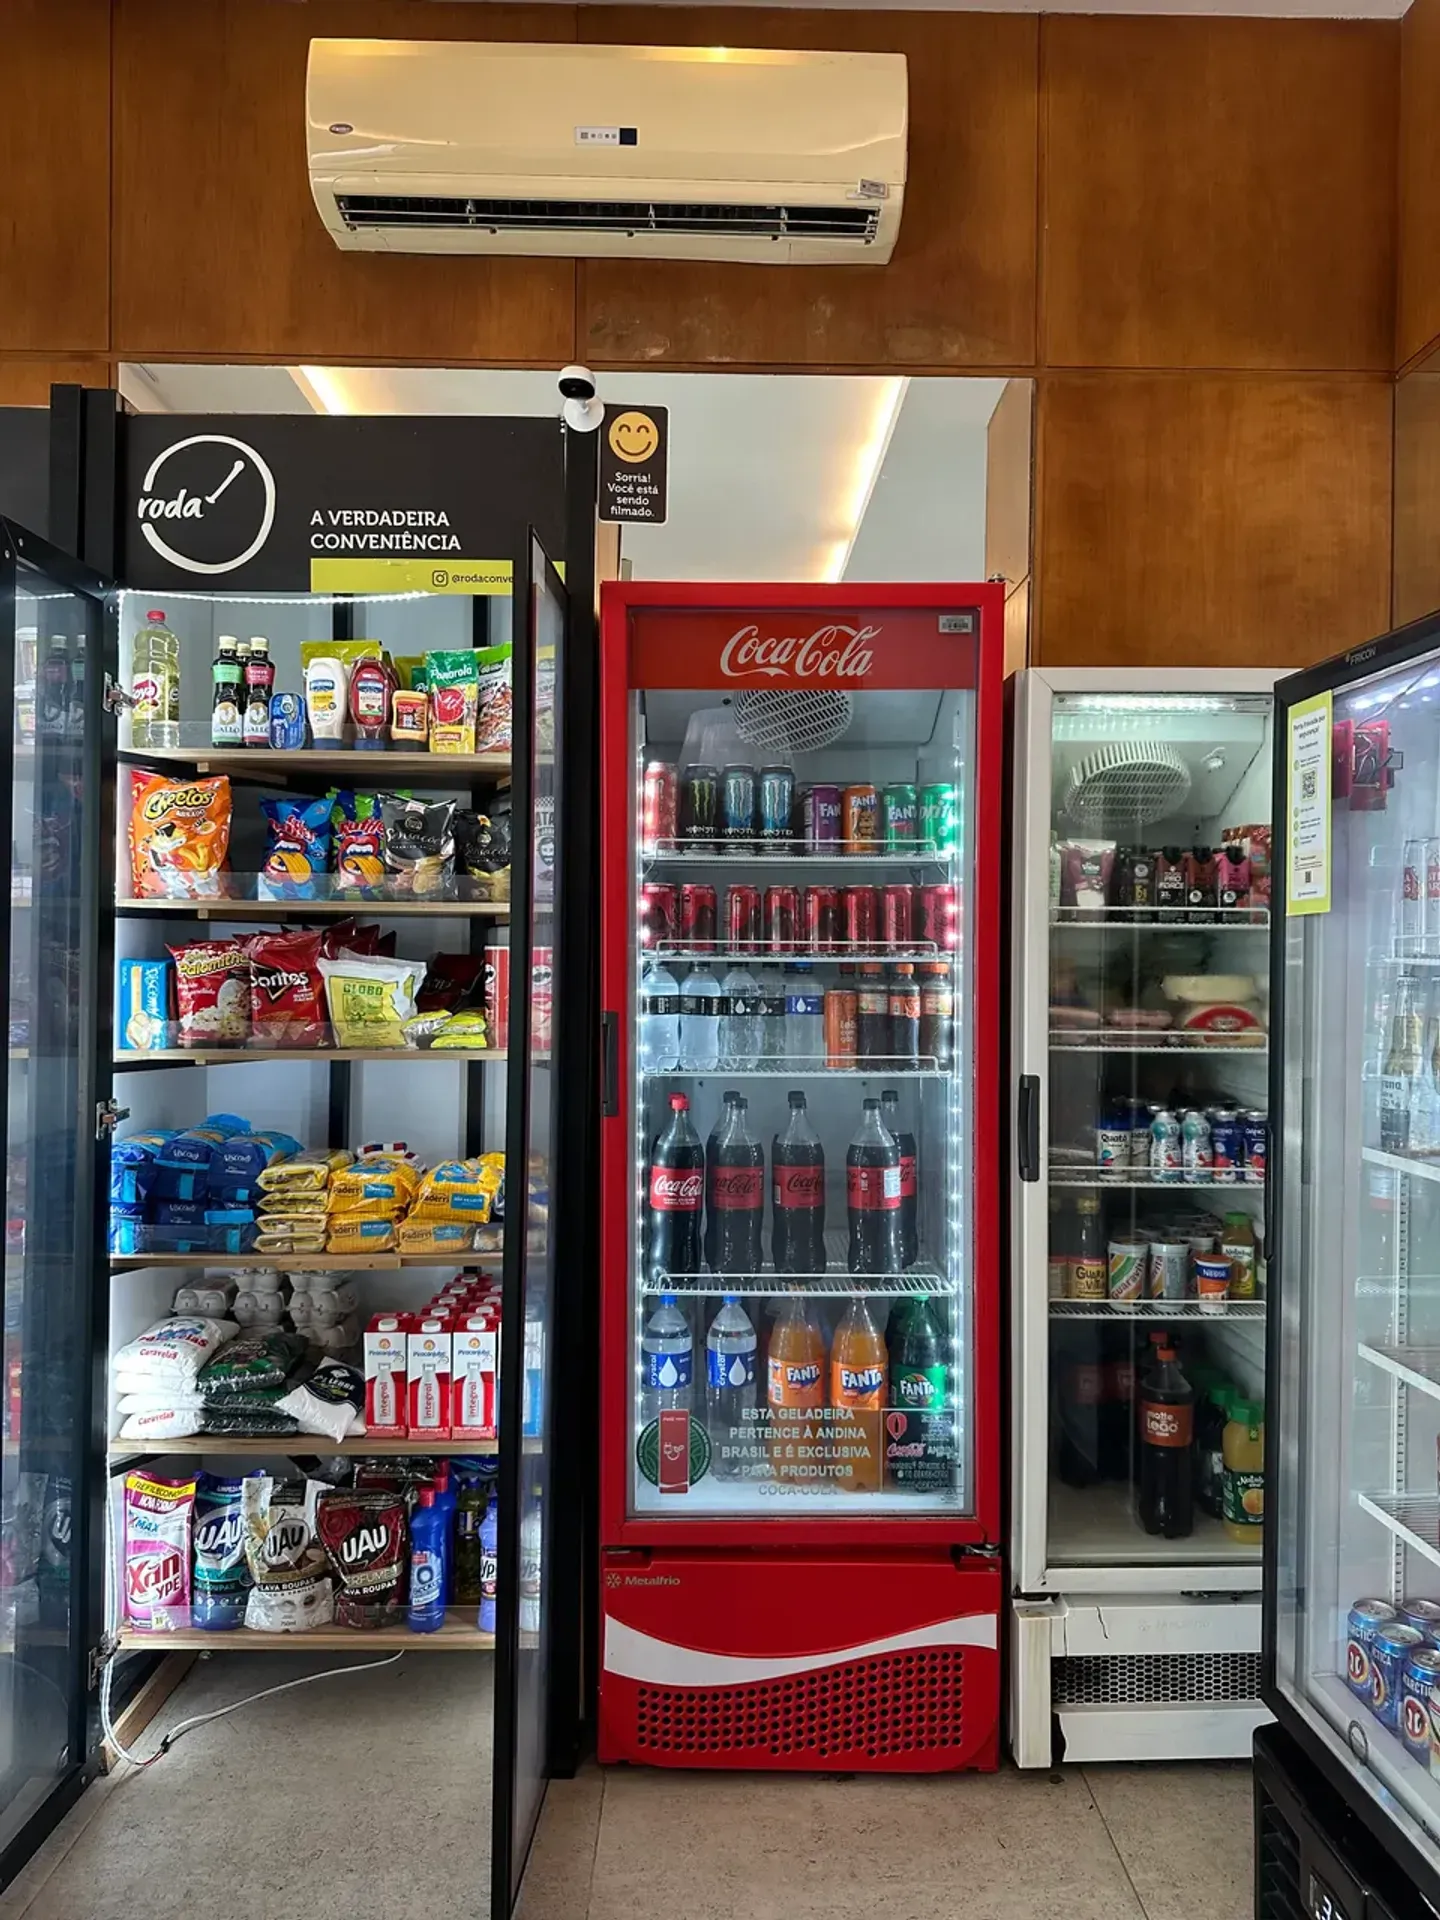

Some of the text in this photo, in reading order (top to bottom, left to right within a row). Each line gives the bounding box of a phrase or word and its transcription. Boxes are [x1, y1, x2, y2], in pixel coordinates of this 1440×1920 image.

[614, 472, 651, 483] Sorria!
[607, 483, 659, 495] Você está
[137, 490, 203, 520] roda
[616, 496, 649, 505] sendo
[310, 510, 450, 528] A VERDADEIRA
[610, 506, 655, 517] filmado.
[310, 531, 461, 551] CONVENIÊNCIA
[719, 625, 883, 678] Coca-Cola
[1350, 646, 1377, 667] FRICON
[143, 787, 215, 821] Cheetos
[343, 983, 384, 996] GLOBO
[785, 1363, 820, 1382] FANTA
[840, 1368, 883, 1389] FANTA
[900, 1380, 935, 1396] FANTA
[741, 1408, 855, 1420] ESTA GELADEIRA
[729, 1427, 800, 1439] PERTENCE
[816, 1427, 867, 1439] ANDINA
[721, 1443, 871, 1458] BRASIL E É EXCLUSIVA
[741, 1465, 853, 1477] PARA PRODUTOS
[758, 1484, 838, 1496] COCA-COLA
[199, 1514, 244, 1551] UAU
[266, 1525, 306, 1559] UAU
[341, 1524, 388, 1563] UAU
[282, 1577, 317, 1591] ROUPAS
[362, 1579, 398, 1595] ROUPAS
[624, 1575, 681, 1587] Metalfrio
